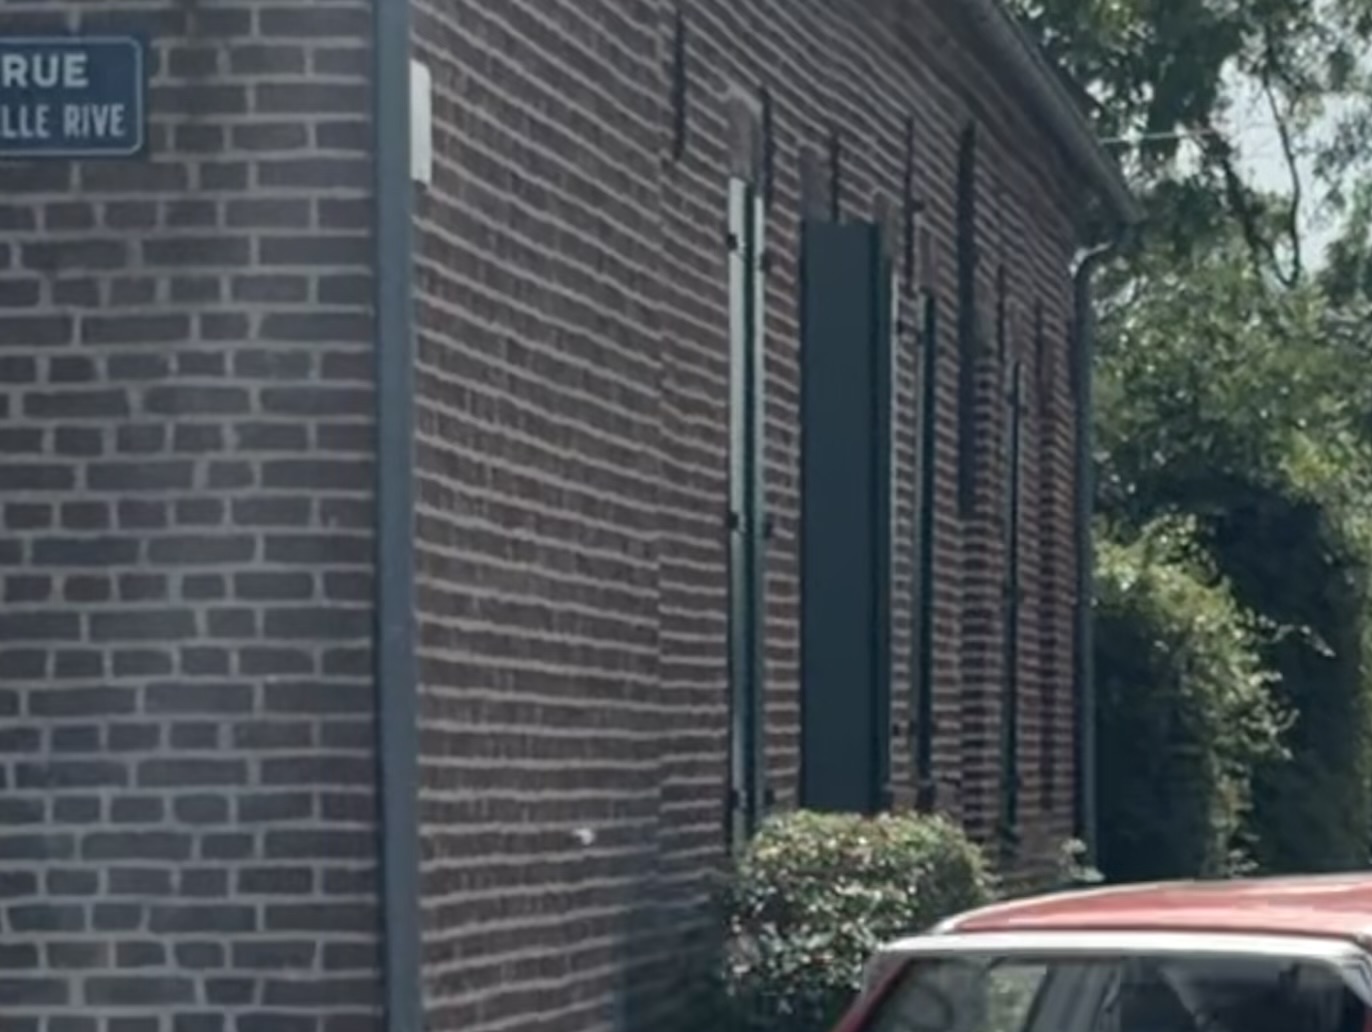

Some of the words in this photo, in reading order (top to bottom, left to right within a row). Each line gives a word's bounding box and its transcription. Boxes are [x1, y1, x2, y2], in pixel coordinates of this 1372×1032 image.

[2, 53, 88, 88] RUE
[0, 104, 51, 139] LLE
[64, 103, 126, 138] RIVE
